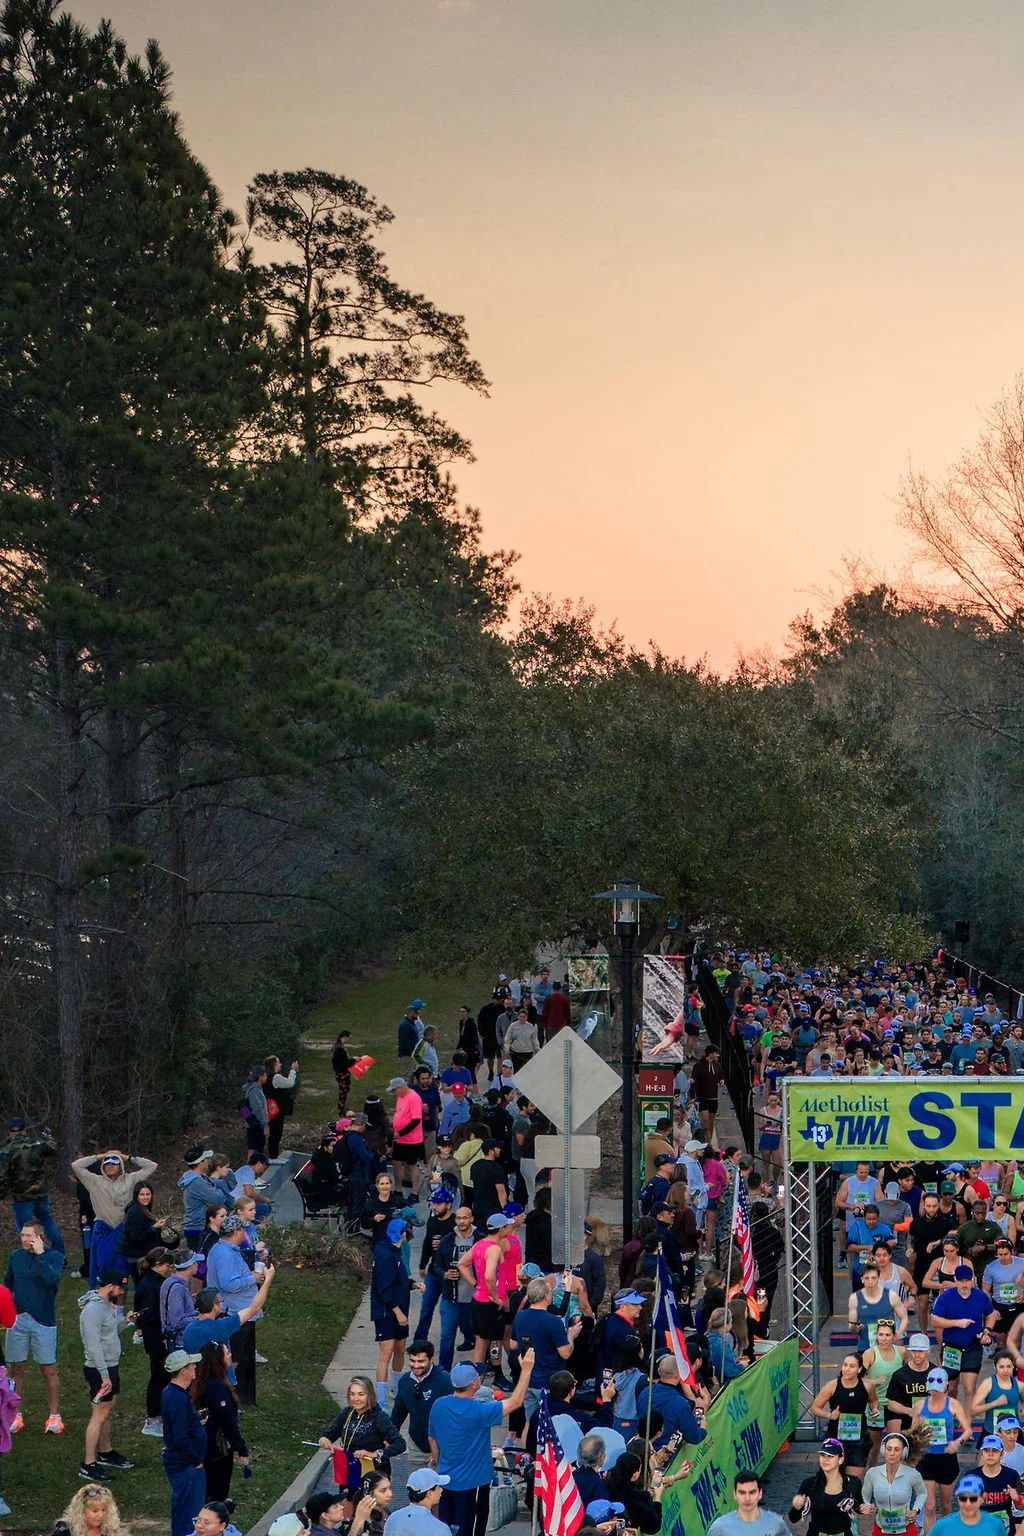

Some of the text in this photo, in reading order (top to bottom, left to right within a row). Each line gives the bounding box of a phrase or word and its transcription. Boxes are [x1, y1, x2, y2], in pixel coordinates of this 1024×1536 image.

[798, 1094, 890, 1112] Methodist
[834, 1115, 890, 1146] TWM
[690, 1466, 719, 1533] TWM
